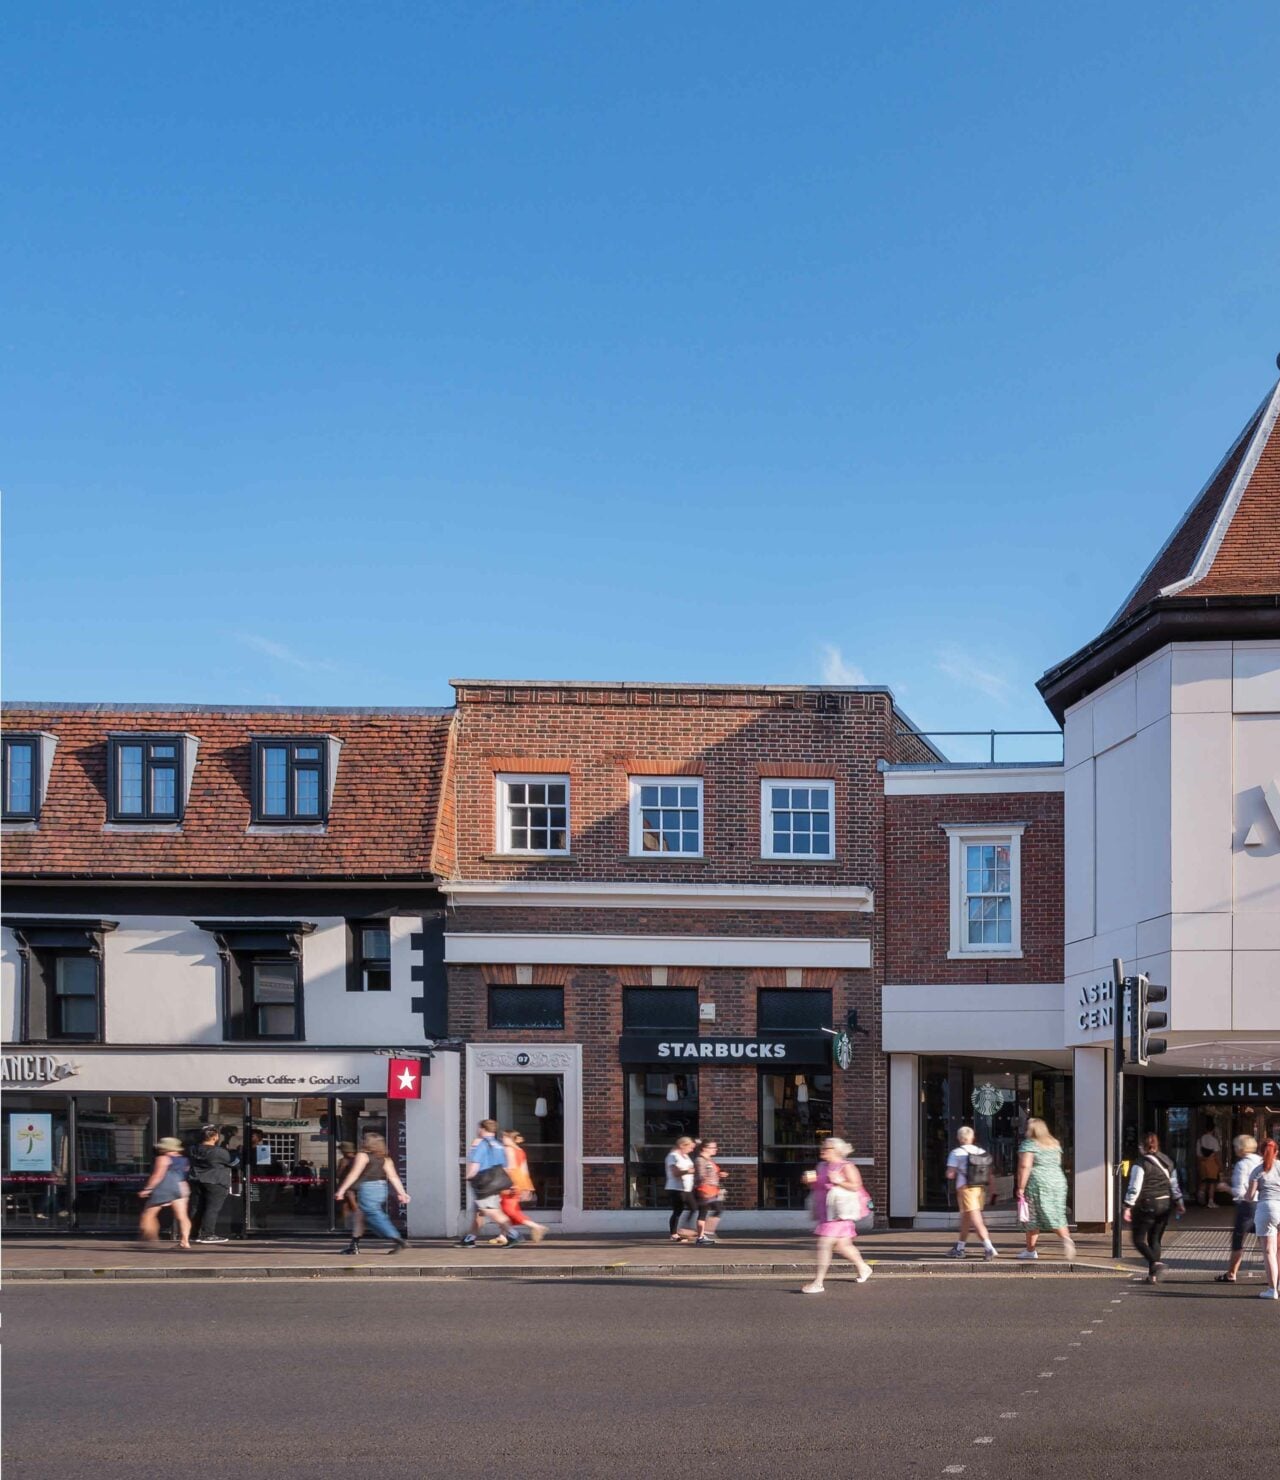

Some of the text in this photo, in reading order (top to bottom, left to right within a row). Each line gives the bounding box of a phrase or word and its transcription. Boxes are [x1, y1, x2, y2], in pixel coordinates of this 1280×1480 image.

[657, 1042, 786, 1058] STARBUCKS
[228, 1075, 360, 1086] Organic Coffee Good Food
